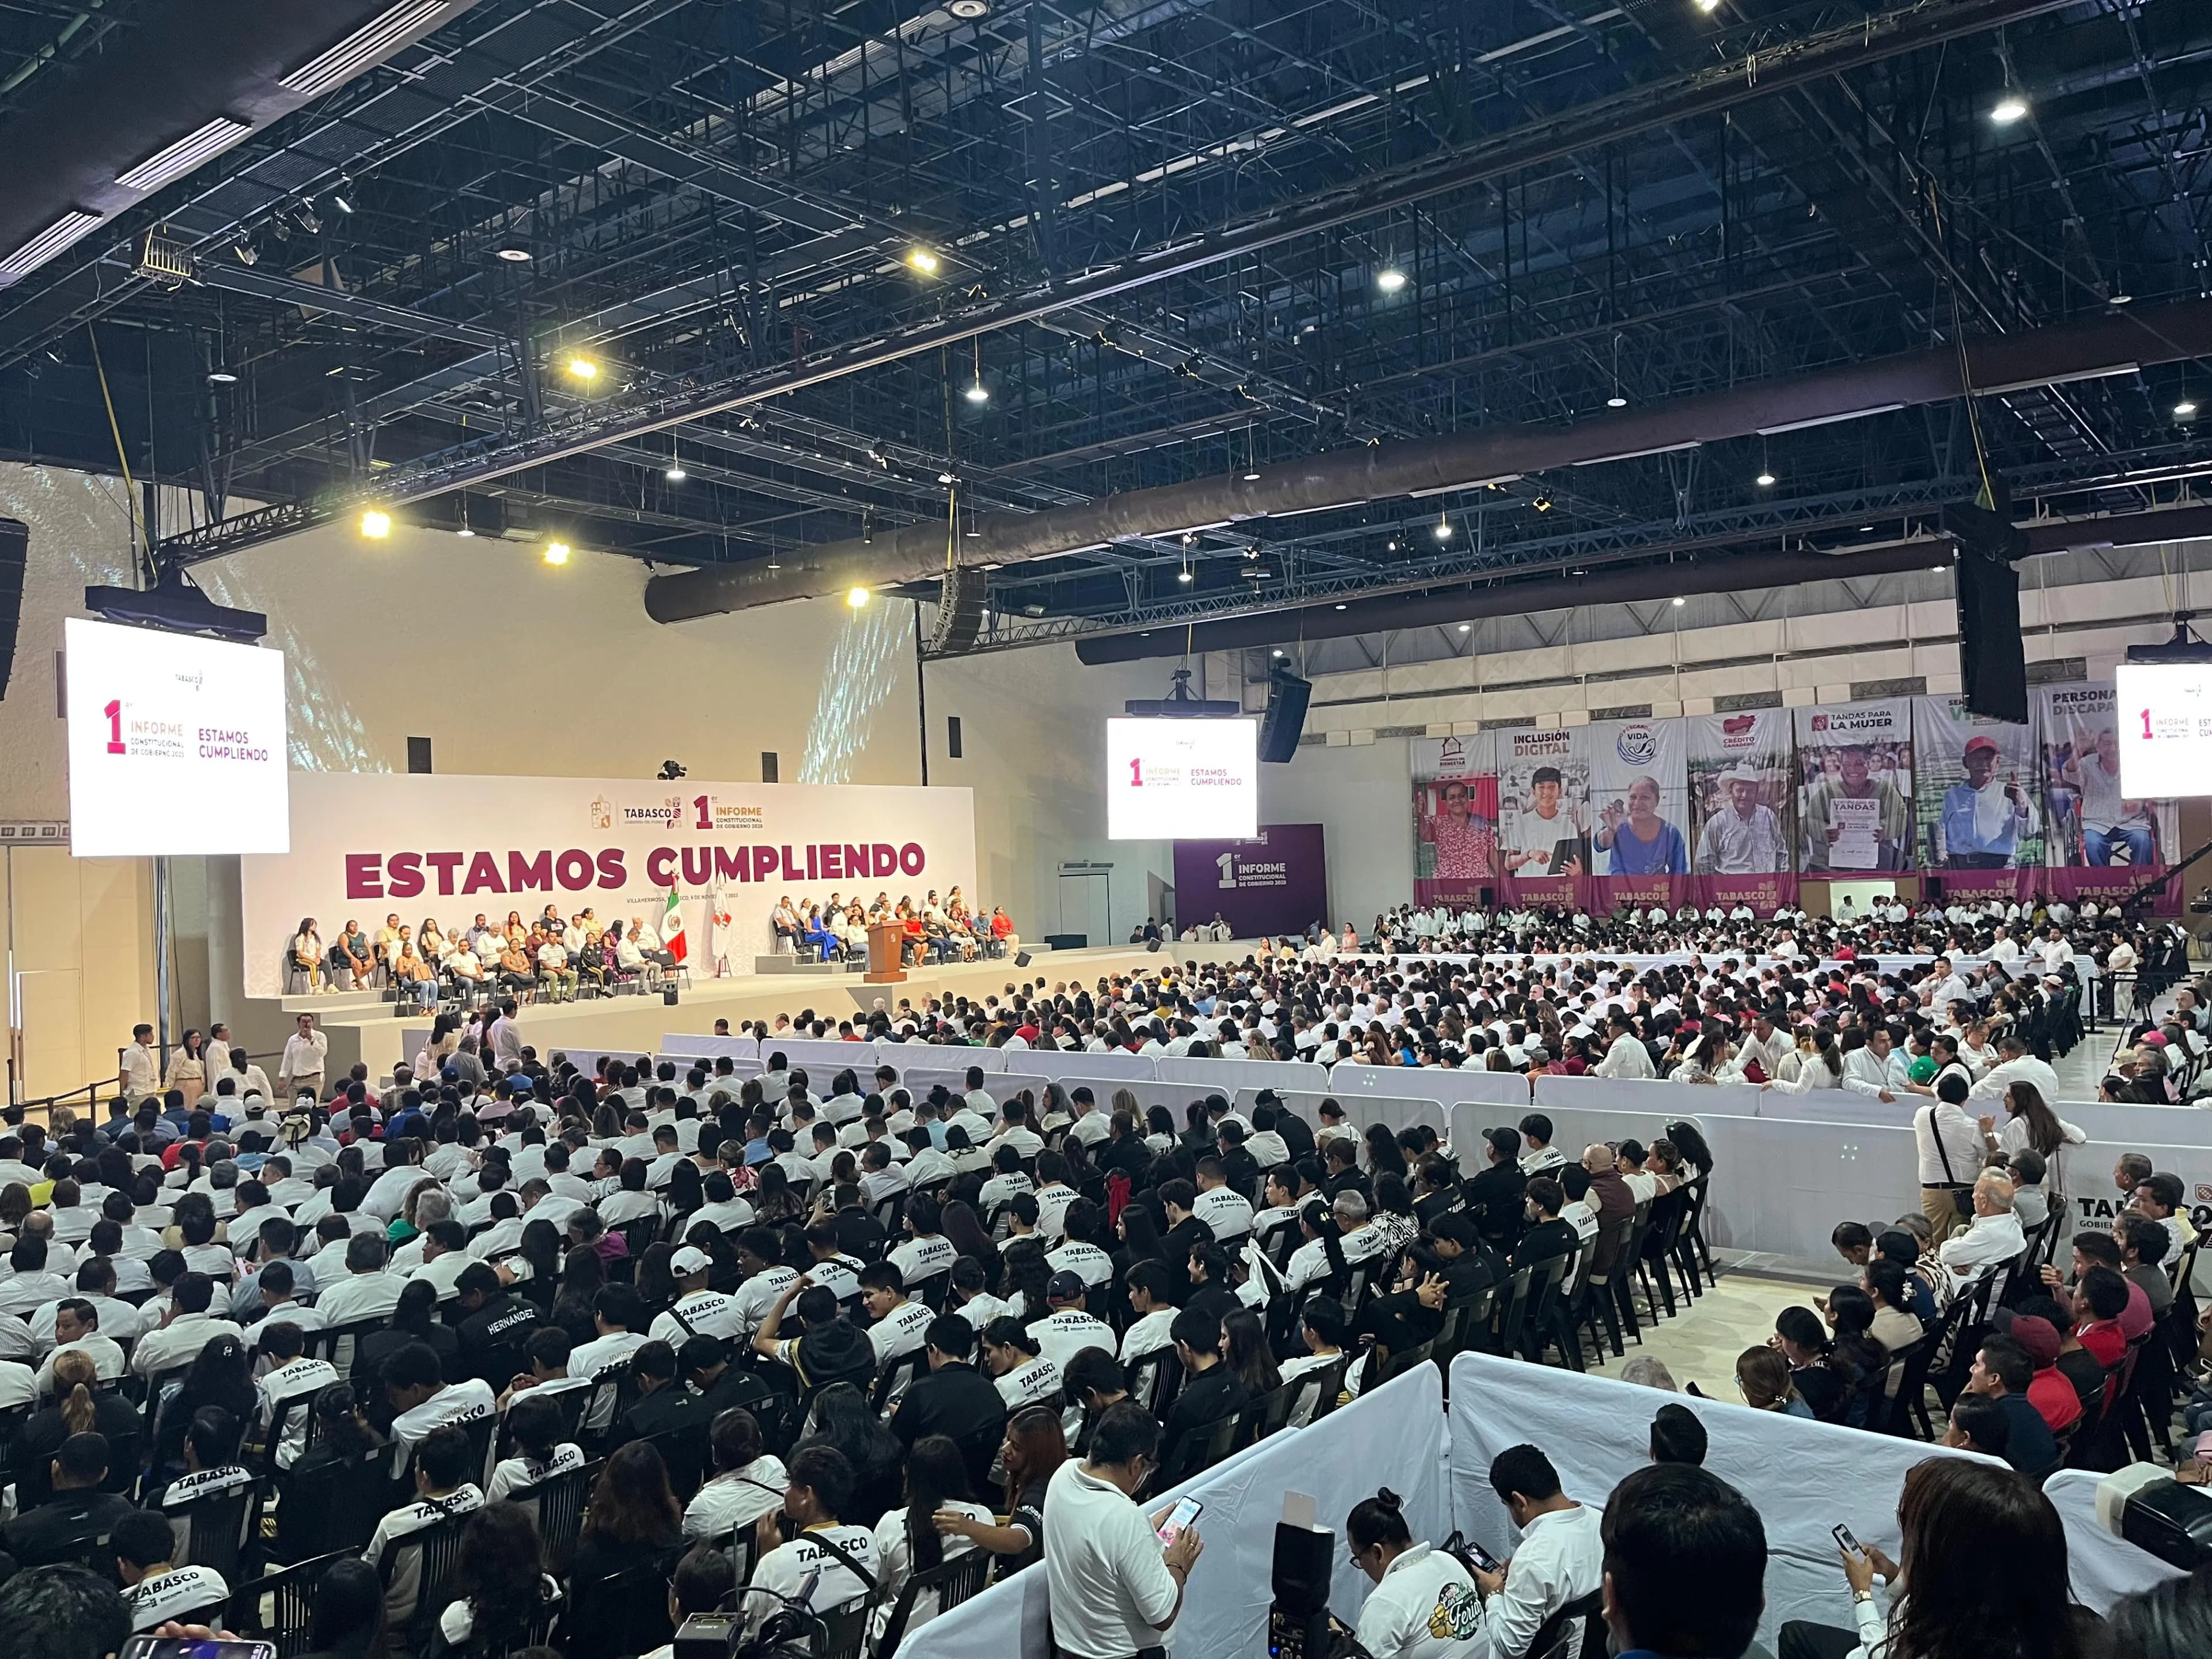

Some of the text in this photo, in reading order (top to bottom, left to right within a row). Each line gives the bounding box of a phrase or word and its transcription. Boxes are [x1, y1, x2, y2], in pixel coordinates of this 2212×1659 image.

[1831, 710, 1891, 721] TANDAS PARA
[104, 699, 126, 755] 1
[131, 720, 184, 737] INFORME
[1622, 724, 1652, 734] PESCANDO
[1831, 718, 1892, 730] LA MUJER
[2140, 708, 2153, 740] 1
[131, 737, 184, 748] CONSTITUCIONAL
[199, 728, 249, 744] ESTAMOS
[1514, 730, 1570, 744] INCLUSIÓN
[199, 745, 268, 762] CUMPLIENDO
[1514, 742, 1570, 757] DIGITAL
[1130, 757, 1143, 787] 1
[1191, 778, 1242, 786] CUMPLIENDO
[624, 808, 672, 818] TABASCO
[693, 795, 713, 830] 1
[715, 807, 763, 816] INFORME
[346, 842, 926, 900] ESTAMOS CUMPLIENDO
[1215, 853, 1237, 888] 1
[1238, 863, 1286, 874] INFORME
[1520, 893, 1565, 902] TABASCO
[1613, 892, 1660, 901] TABASCO
[1715, 892, 1766, 900] TABASCO
[1946, 889, 2005, 899] TABASCO
[2075, 885, 2138, 896] TABASCO
[1433, 894, 1474, 903] TABASCO
[1210, 1195, 1244, 1203] TABASCO
[917, 1242, 950, 1257] TABASCO
[487, 1308, 536, 1335] HERNANDEZ
[896, 1307, 930, 1327] TABASCO
[1019, 1362, 1056, 1388] TABASCO
[527, 1450, 575, 1480] TABASCO
[177, 1465, 240, 1491] TABASCO
[414, 1490, 473, 1519] TAASCO
[796, 1536, 868, 1563] TABSCO
[1448, 1599, 1481, 1633] Feria
